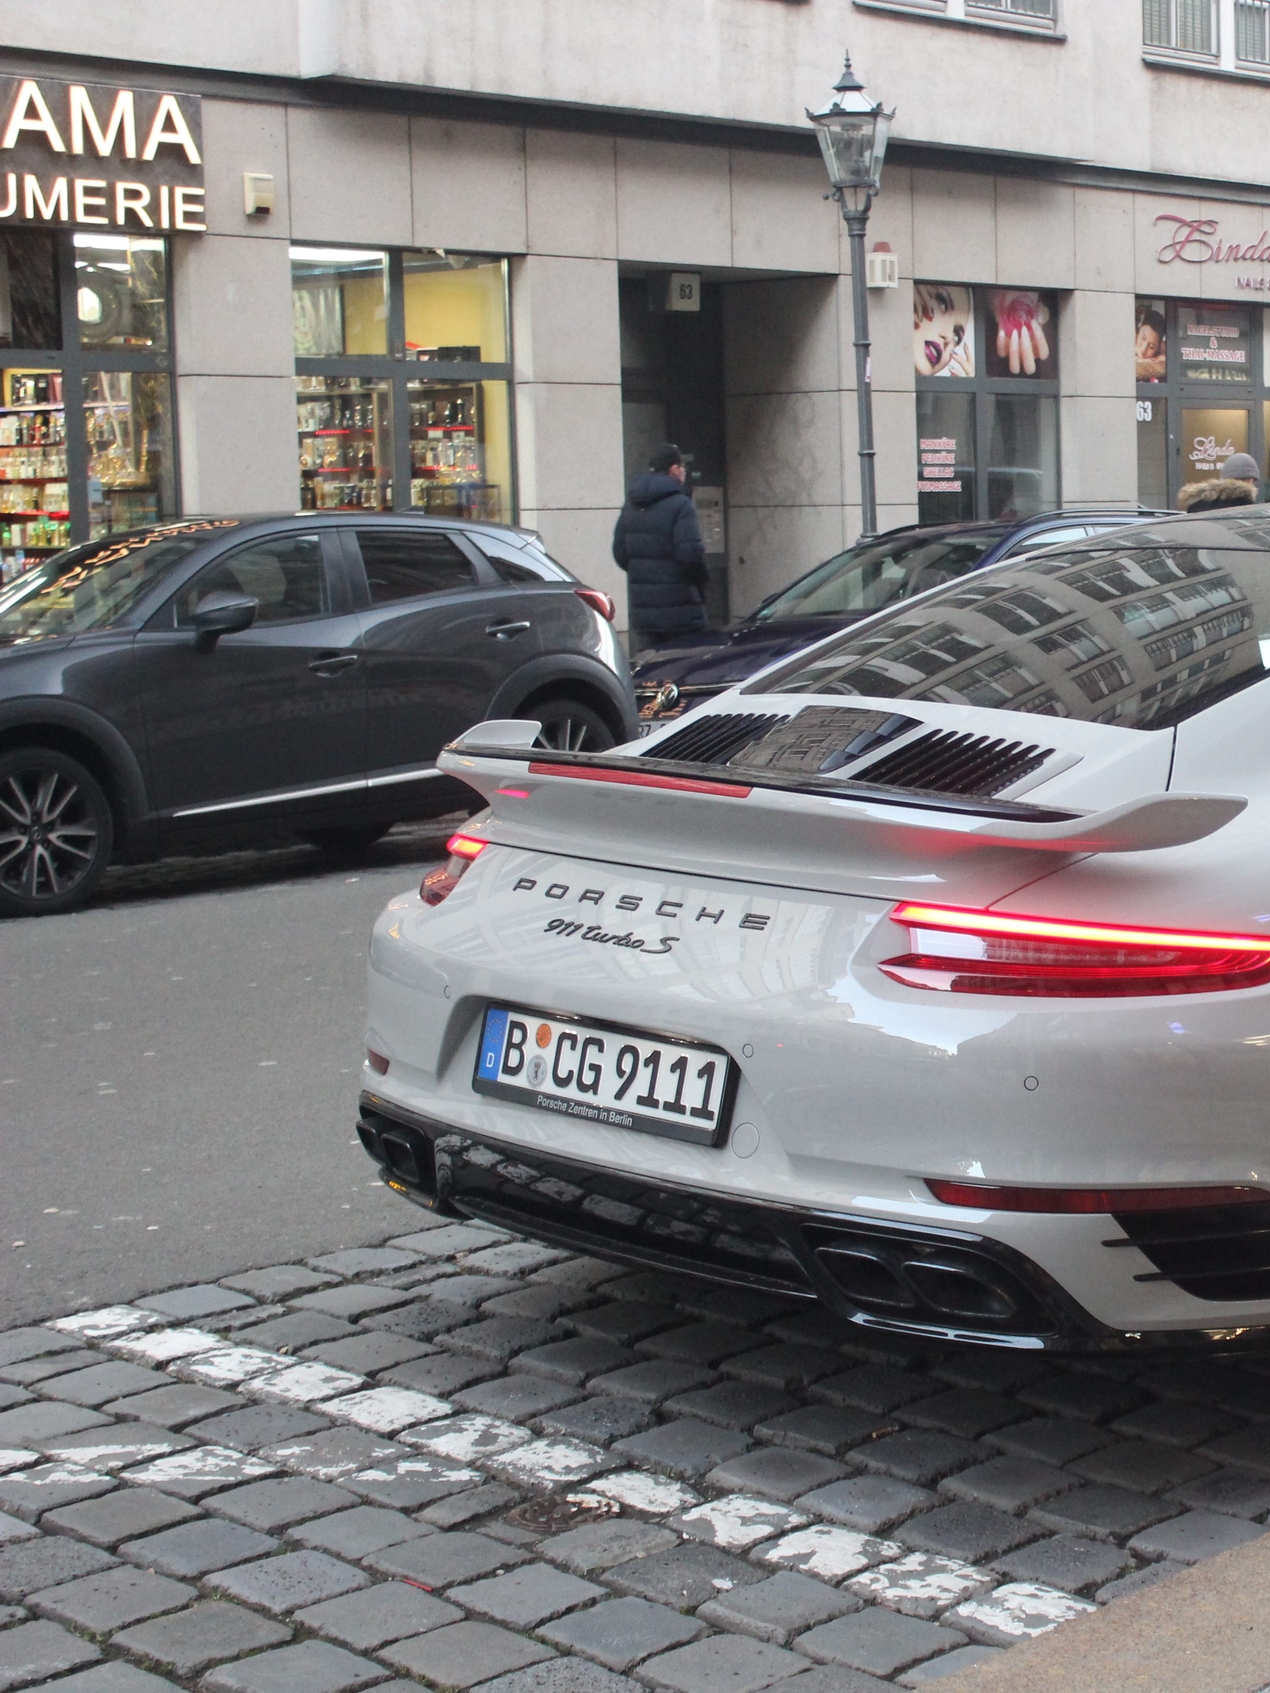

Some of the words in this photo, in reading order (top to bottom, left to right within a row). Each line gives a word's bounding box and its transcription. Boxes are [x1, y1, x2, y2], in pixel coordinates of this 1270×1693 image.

[2, 80, 202, 164] AMA
[680, 283, 693, 300] 63
[1236, 276, 1264, 291] NAILS
[1187, 324, 1240, 338] NAGELSTUDIO
[1209, 336, 1218, 349] &
[1181, 347, 1246, 363] THAI-MASSAGE
[1136, 401, 1152, 422] 63
[920, 436, 957, 450] MANIKÜRE
[921, 451, 956, 464] PEDIKÜRE
[923, 466, 955, 478] SHELLAC
[512, 877, 771, 931] PORSCHE
[544, 918, 584, 937] 911
[581, 925, 645, 949] turbo
[640, 936, 680, 954] S
[486, 1052, 496, 1069] D
[501, 1019, 529, 1077] B
[552, 1029, 606, 1096] CG
[613, 1044, 718, 1122] 9111
[537, 1095, 567, 1111] Porsche
[568, 1102, 597, 1119] Zentren
[599, 1108, 607, 1121] in
[609, 1111, 633, 1127] Berlin
